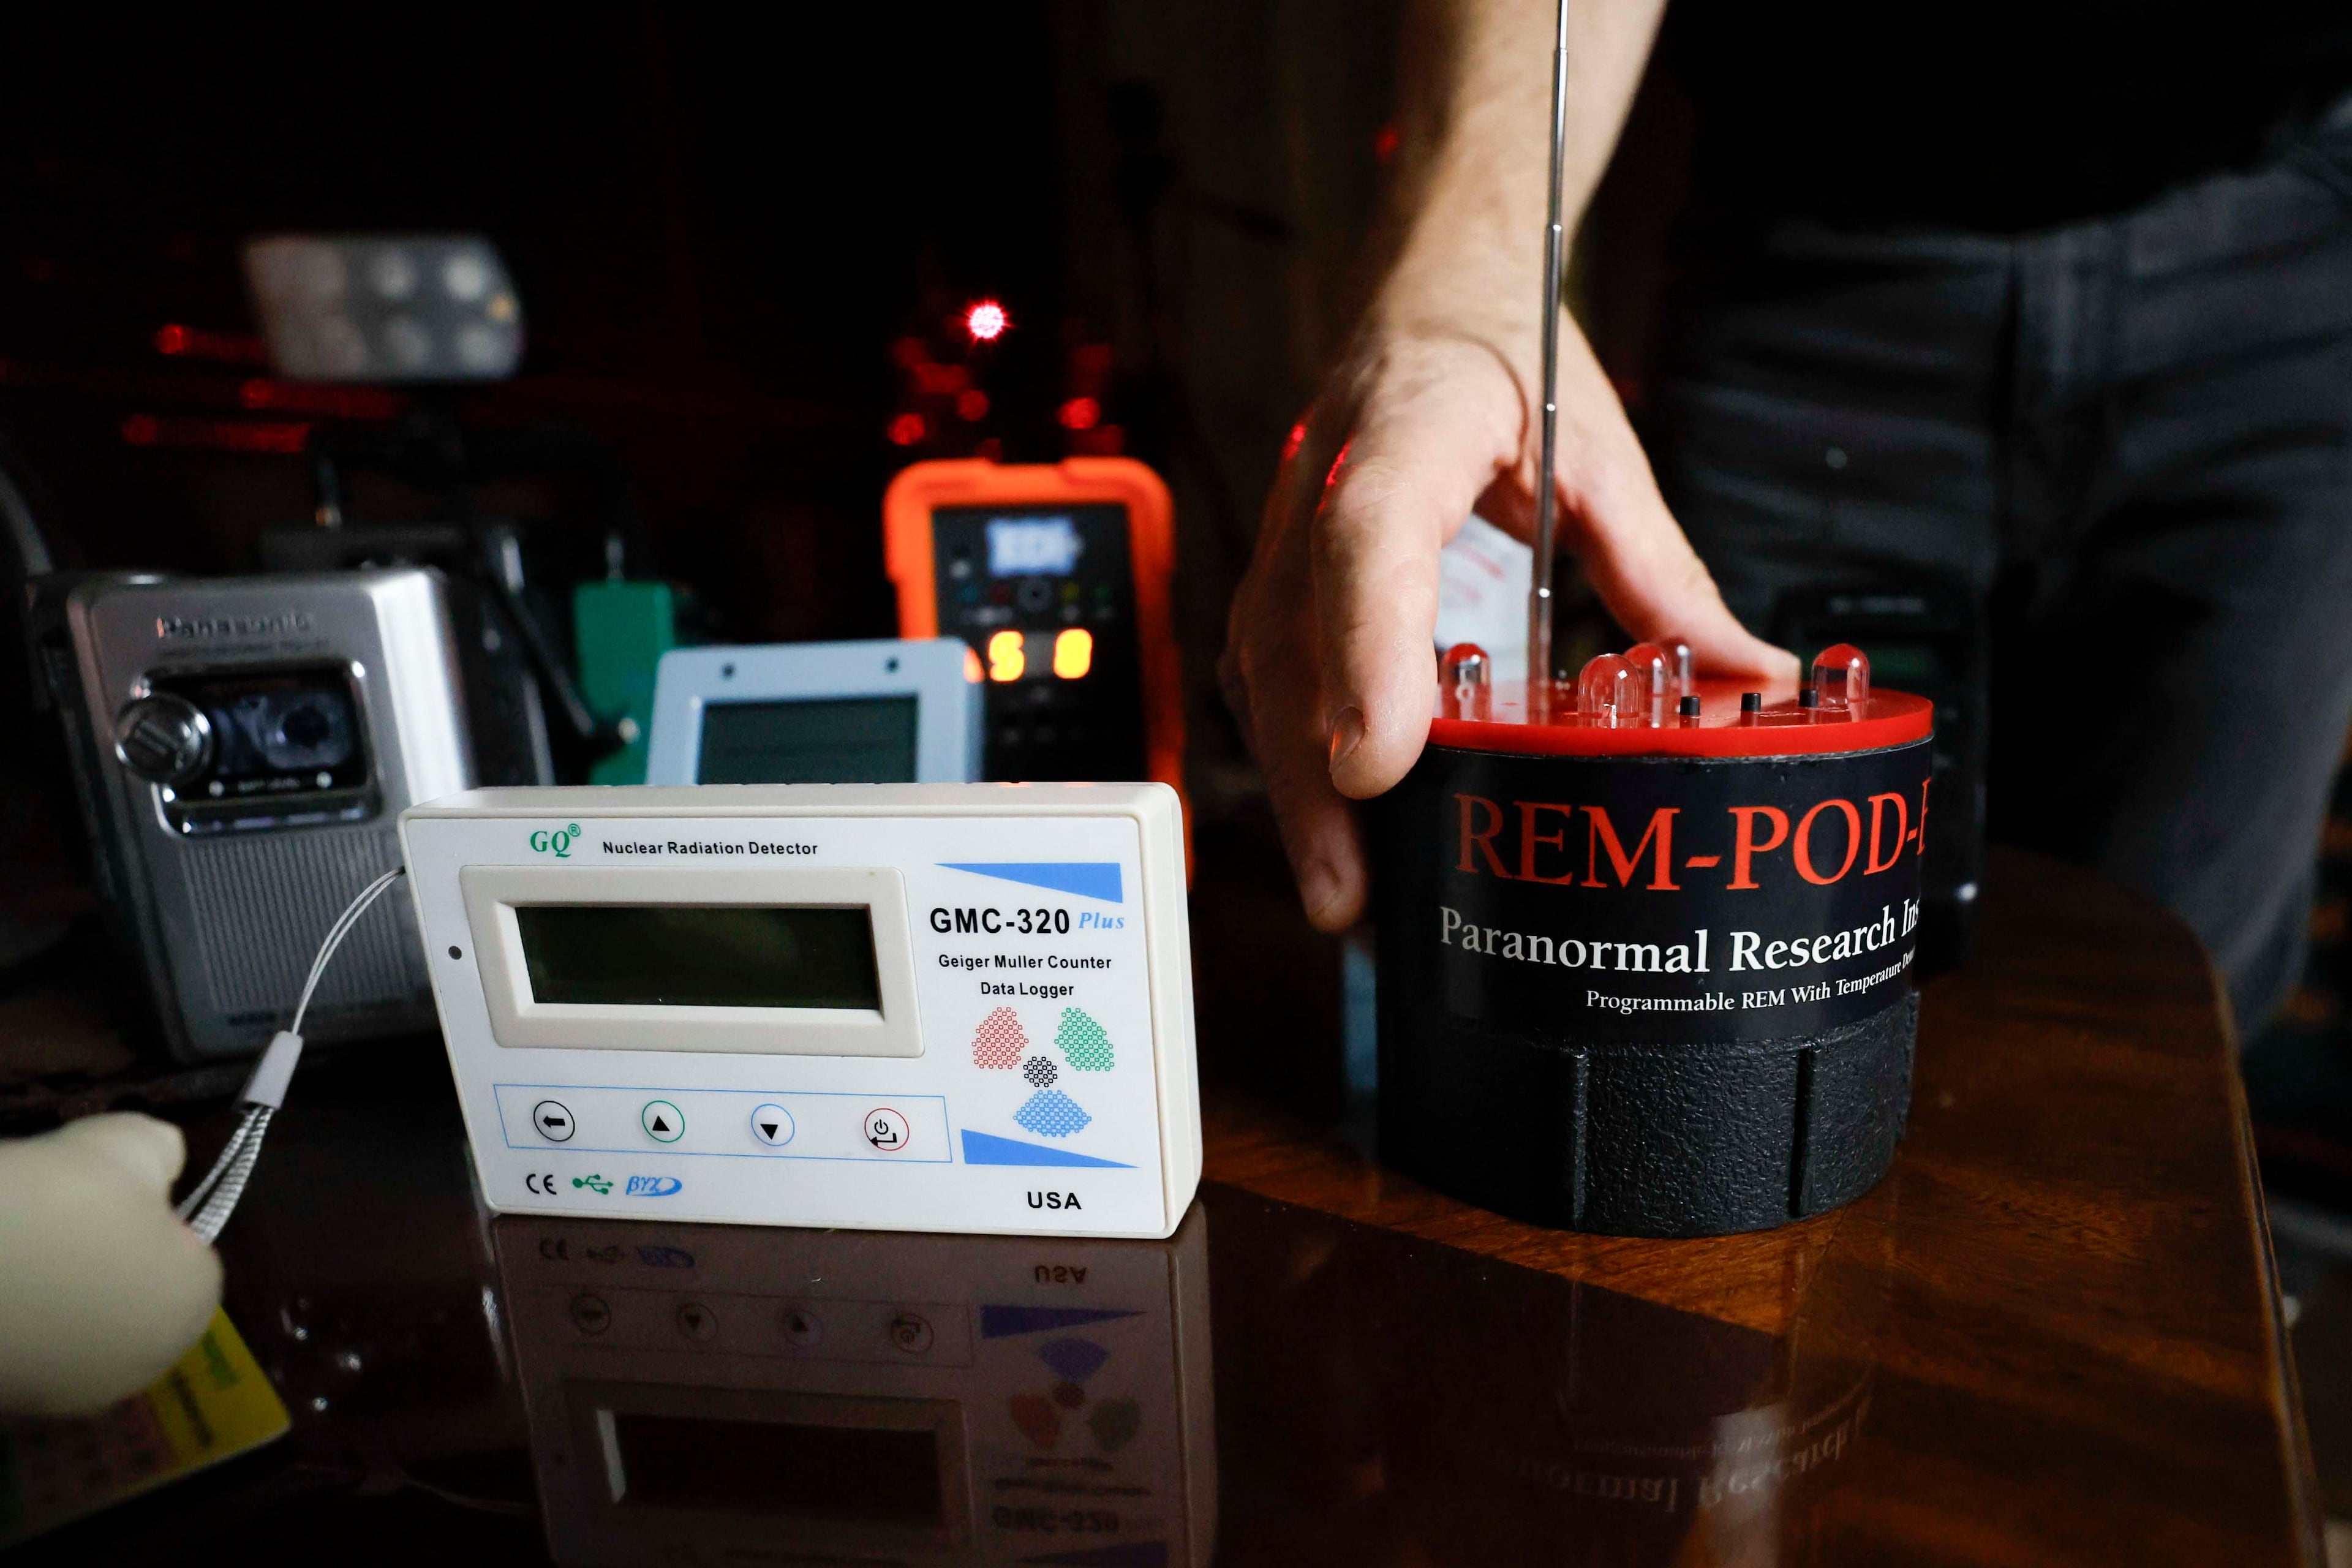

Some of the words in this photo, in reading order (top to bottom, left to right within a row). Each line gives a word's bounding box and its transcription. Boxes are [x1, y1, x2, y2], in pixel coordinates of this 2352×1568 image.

[603, 841, 663, 854] Nuclear
[667, 842, 744, 855] Radiation
[748, 842, 818, 855] Detector
[930, 908, 1070, 934] GMC-320
[1078, 911, 1125, 930] Plus
[1440, 907, 1711, 973] Paranormal
[1729, 905, 1895, 971] Research
[938, 954, 990, 971] Geiger
[994, 955, 1044, 969] Muller
[1047, 956, 1112, 970] Counter
[980, 982, 1015, 995] Data
[1019, 982, 1074, 998] Logger
[1586, 990, 1735, 1015] Programmable
[1741, 989, 1785, 1009] REM
[1790, 982, 1831, 1003] With
[1836, 961, 1901, 993] Temperature
[1027, 1191, 1082, 1210] USA
